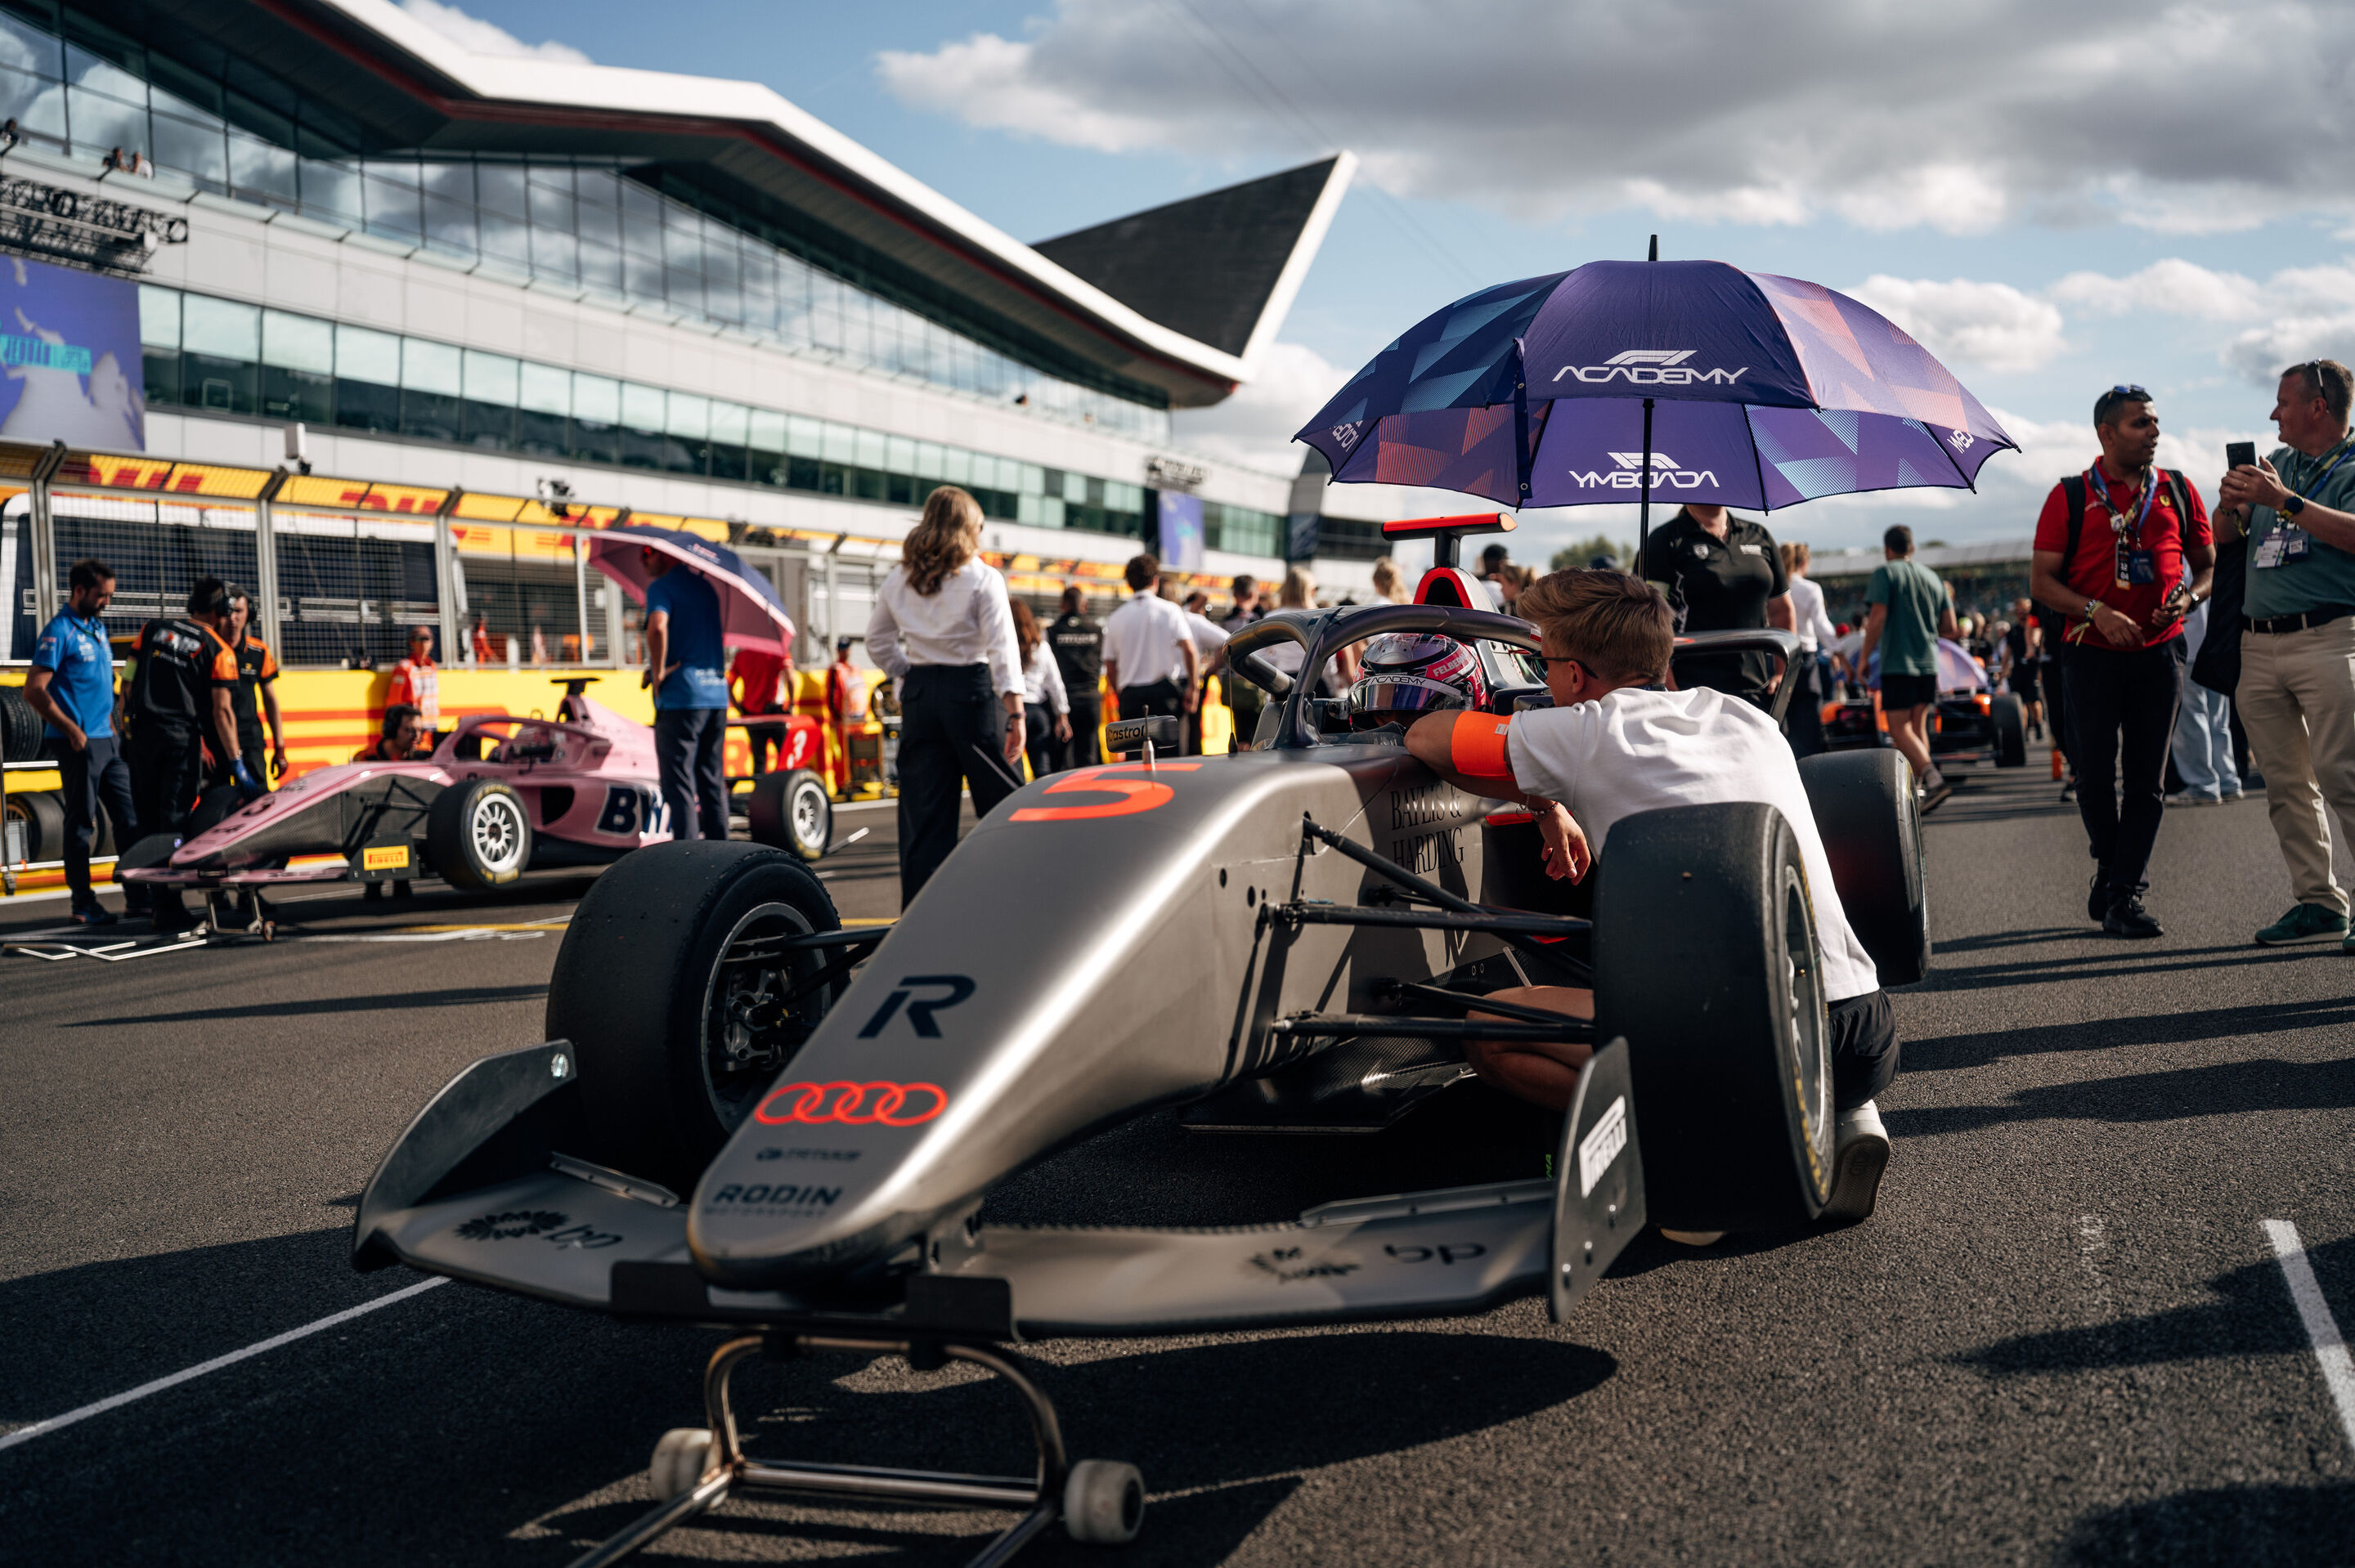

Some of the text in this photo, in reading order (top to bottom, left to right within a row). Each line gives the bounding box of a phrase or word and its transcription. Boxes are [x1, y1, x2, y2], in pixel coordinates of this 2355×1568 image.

[1552, 365, 1750, 385] ACADEMY
[1371, 674, 1426, 686] ACADEMY
[1008, 763, 1204, 822] 5
[1390, 784, 1446, 831] BAYLIS
[1393, 827, 1464, 876] HARDING
[1578, 1094, 1628, 1200] PIRELLI
[713, 1184, 844, 1207] RODIN
[1384, 1242, 1487, 1265] bp
